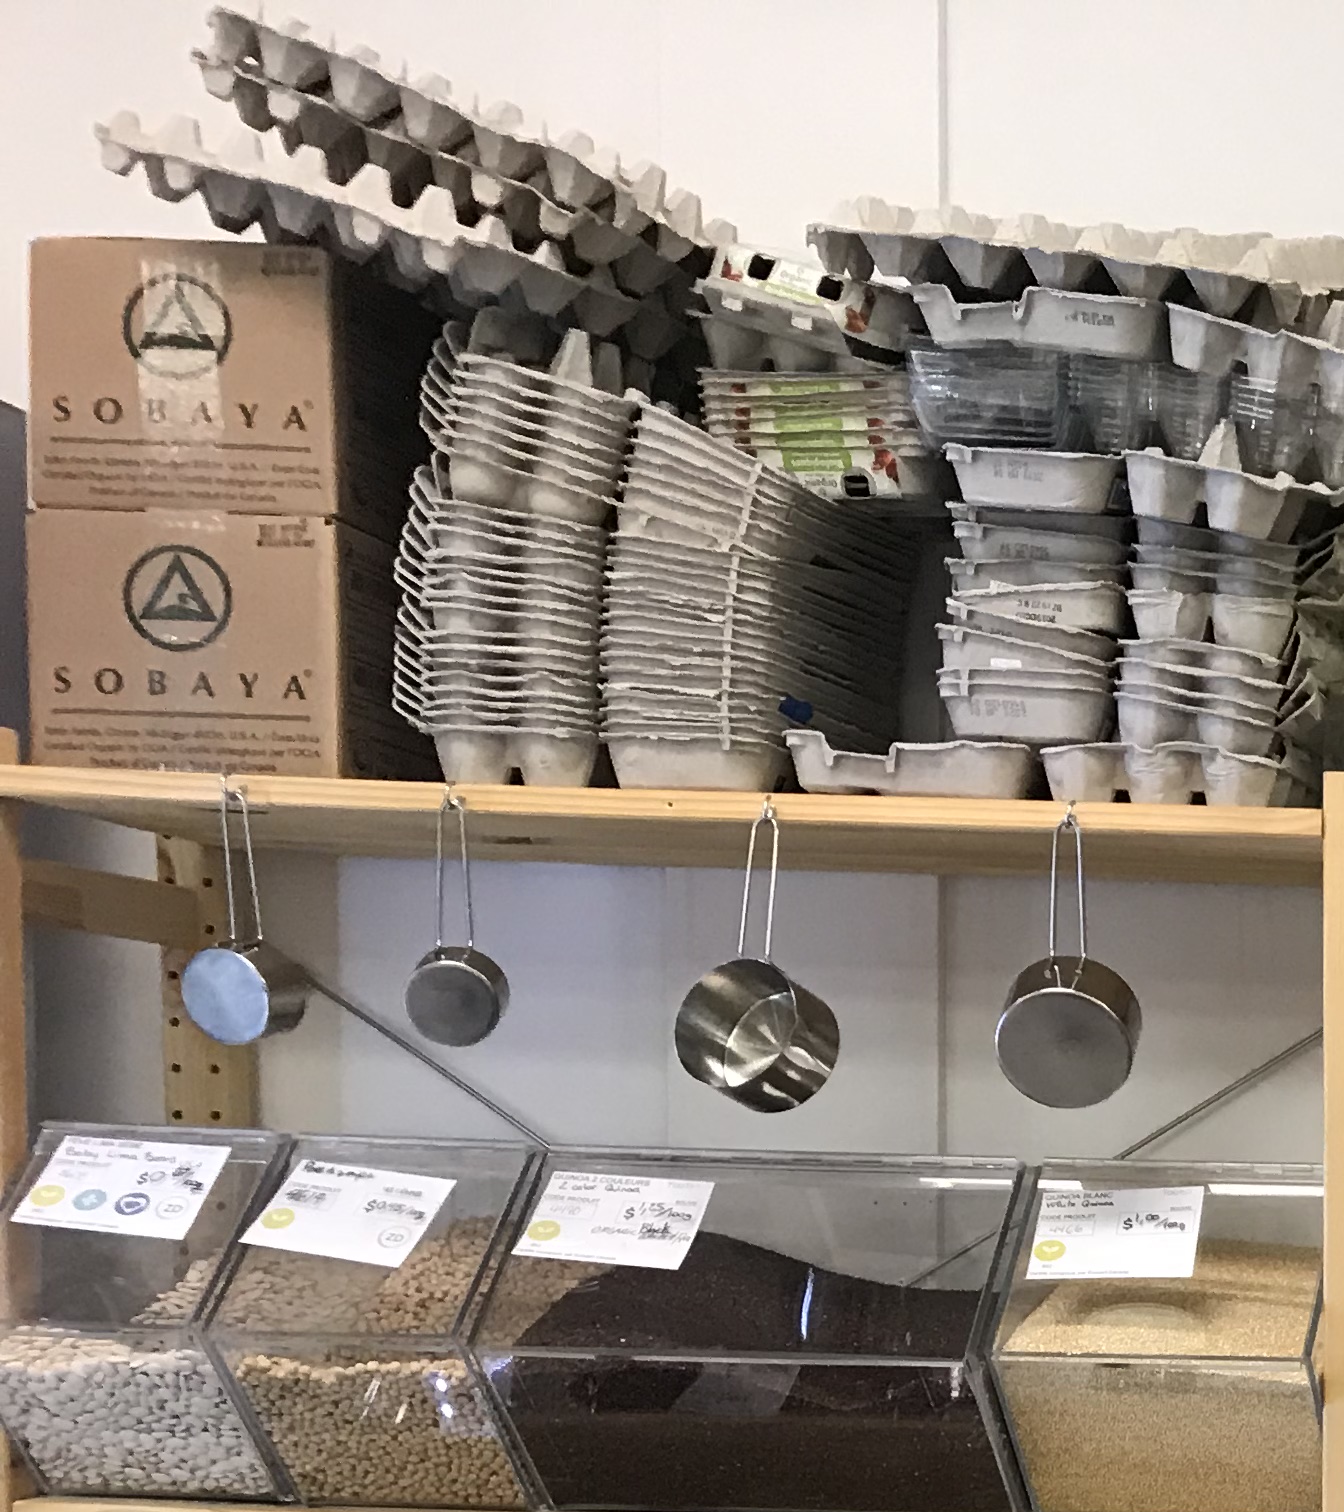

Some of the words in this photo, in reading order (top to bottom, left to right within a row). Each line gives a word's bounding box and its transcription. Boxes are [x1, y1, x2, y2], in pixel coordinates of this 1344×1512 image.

[52, 395, 307, 433] SOBAYA
[53, 665, 307, 701] SOBAYA
[385, 1232, 405, 1244] ZD
